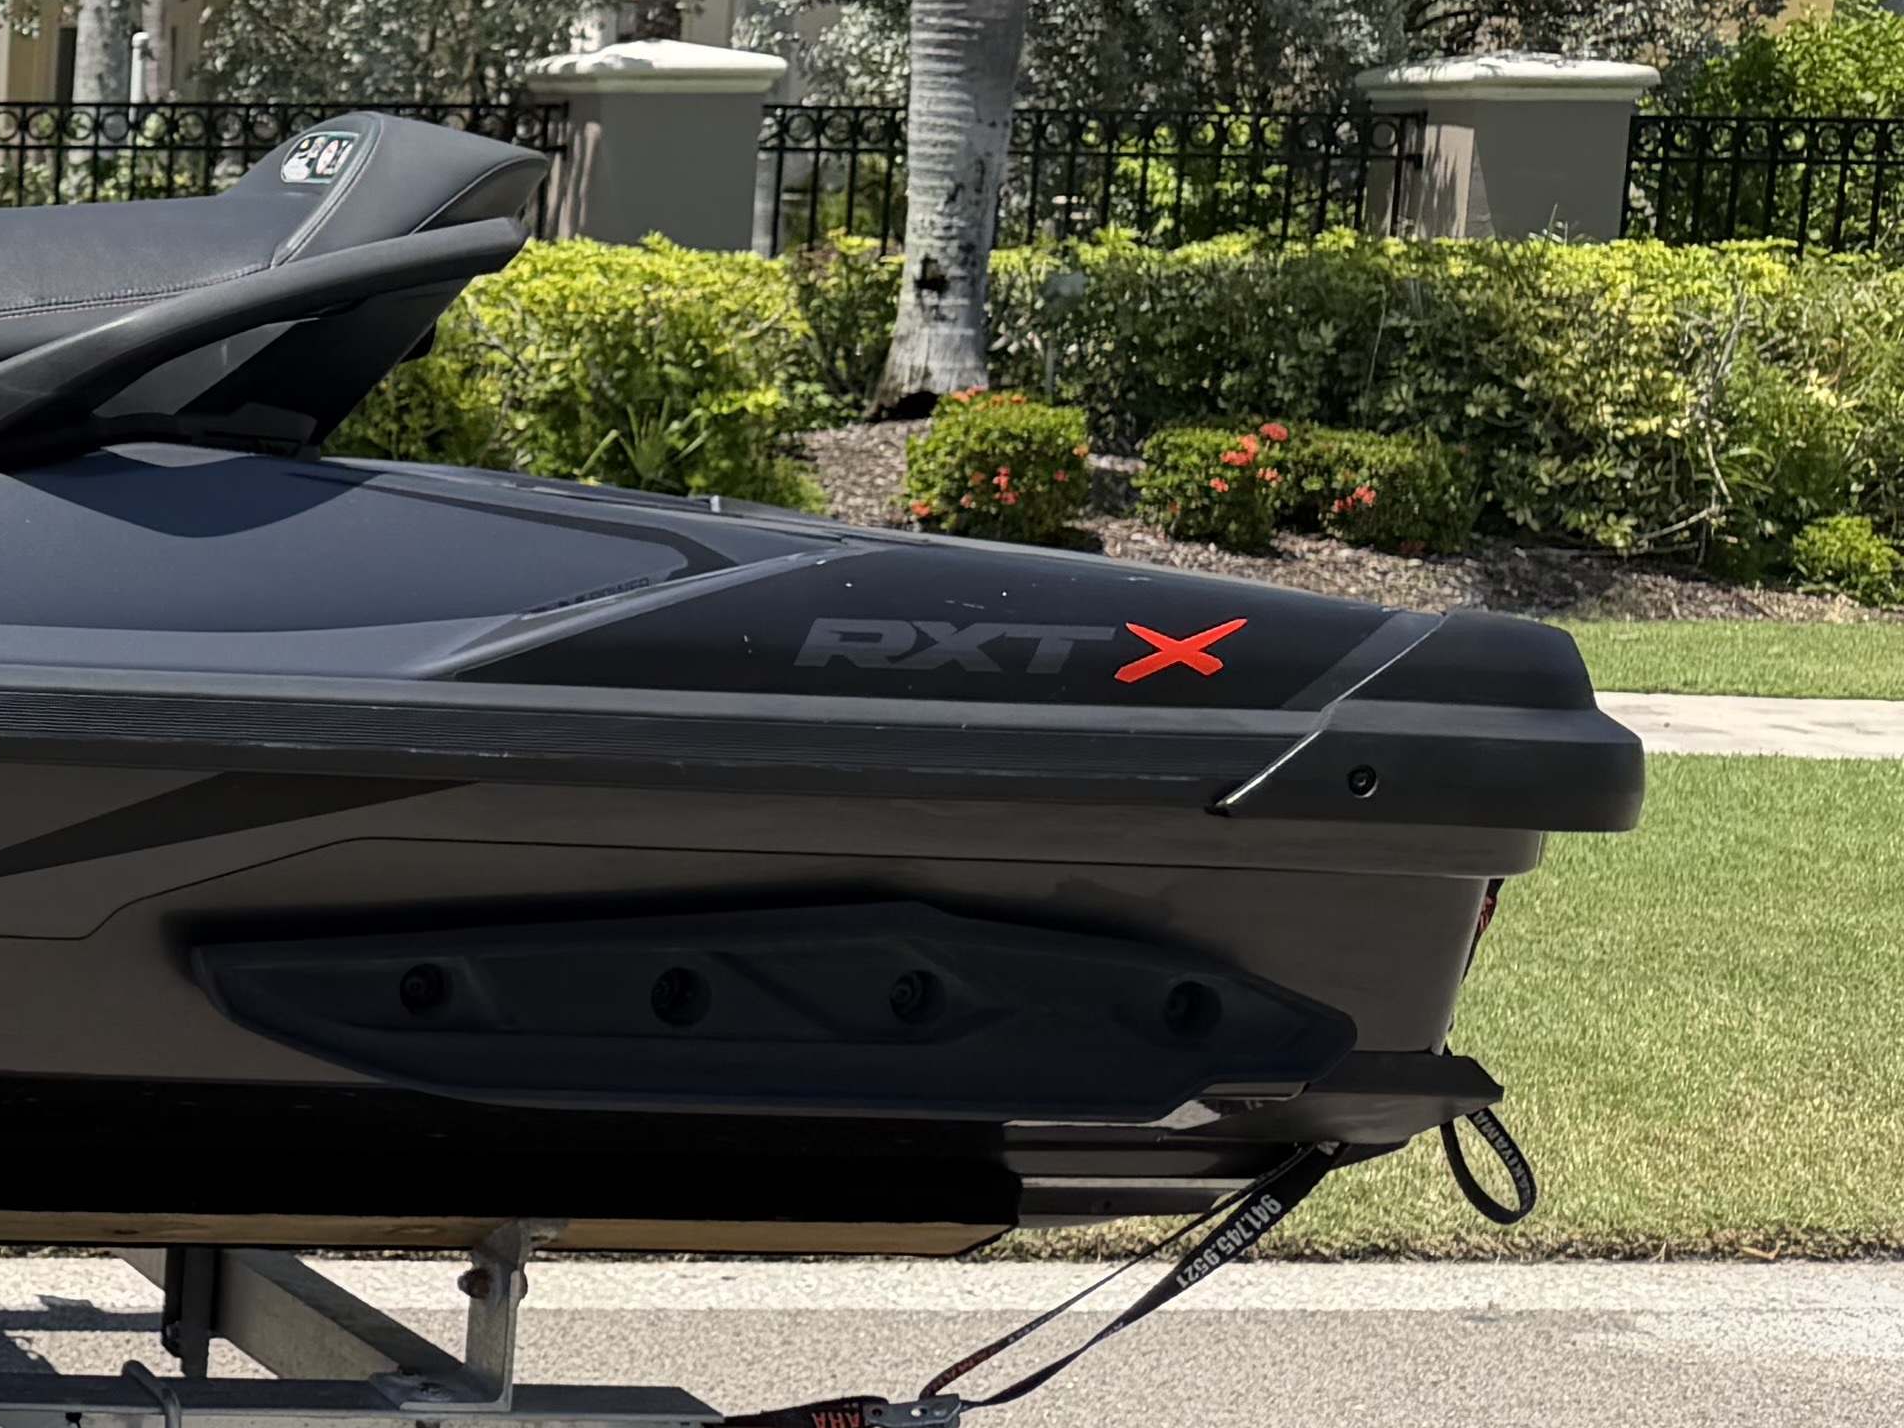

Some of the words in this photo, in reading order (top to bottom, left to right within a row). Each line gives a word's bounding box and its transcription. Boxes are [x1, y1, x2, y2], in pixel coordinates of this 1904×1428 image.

[793, 617, 1116, 674] RXT
[1114, 617, 1248, 683] X
[1175, 1193, 1283, 1290] 941.745.9521
